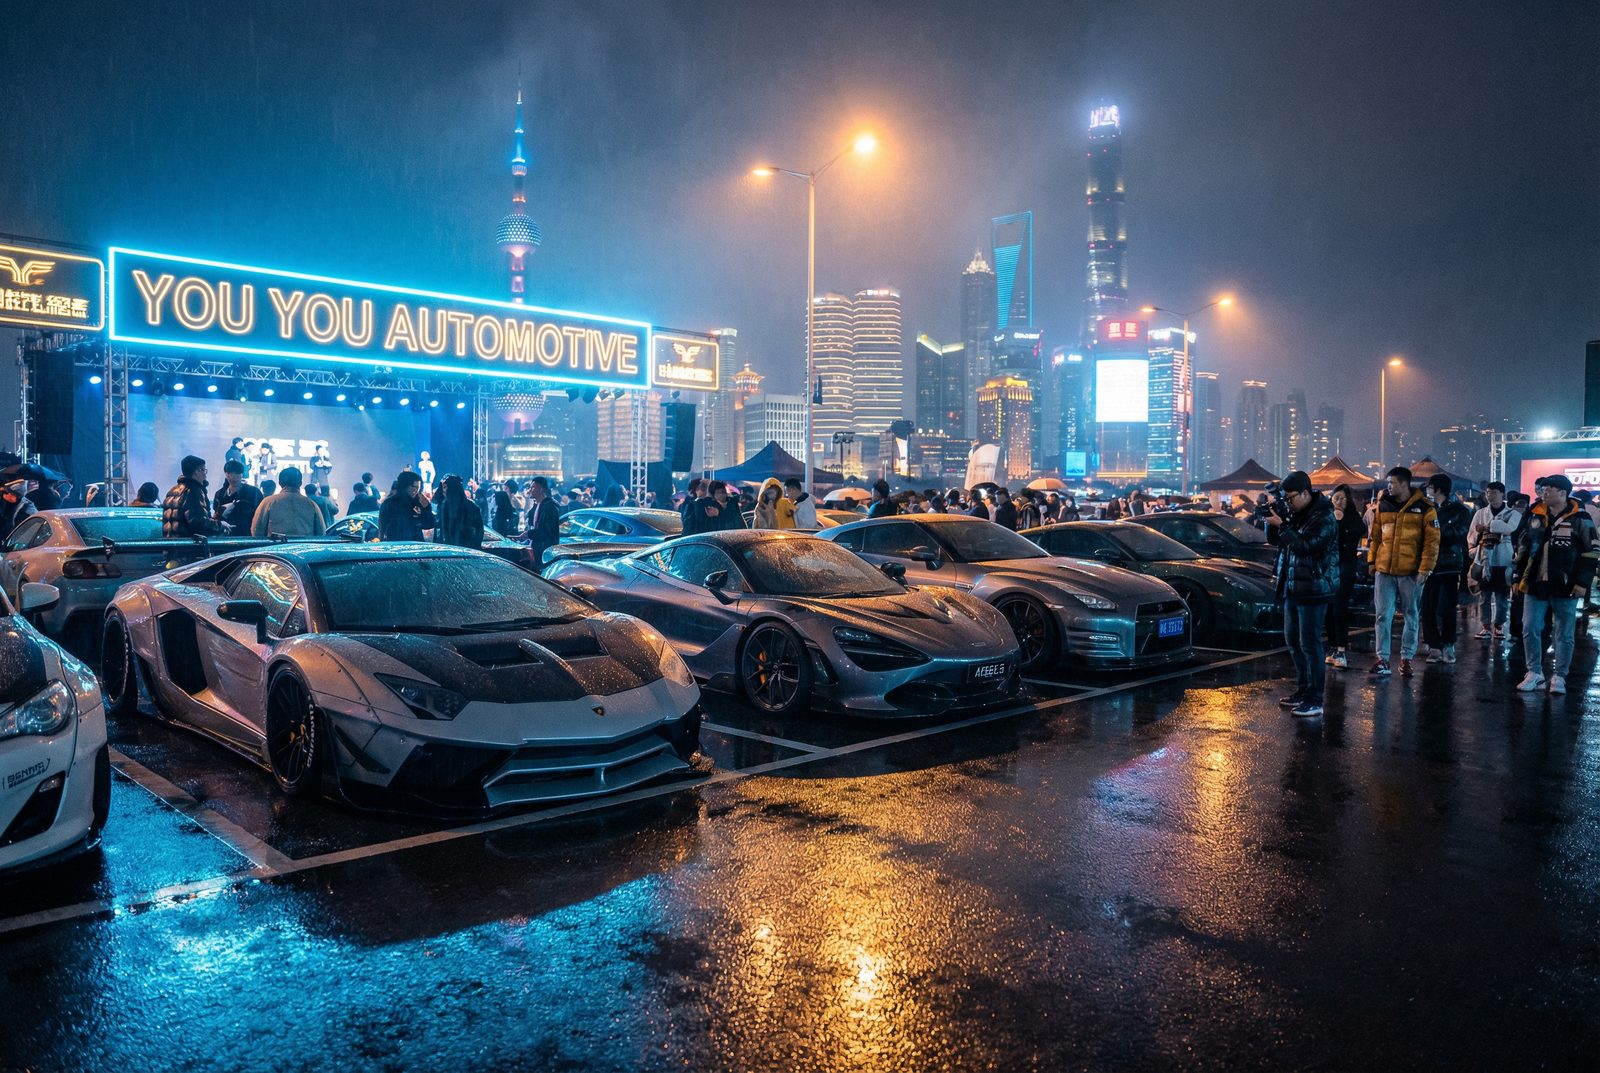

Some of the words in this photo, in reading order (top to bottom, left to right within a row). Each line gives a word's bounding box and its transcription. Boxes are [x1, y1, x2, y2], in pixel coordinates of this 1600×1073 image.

[132, 269, 255, 335] YOU
[267, 287, 374, 347] YOU
[384, 303, 638, 375] AUTOMOTIVE
